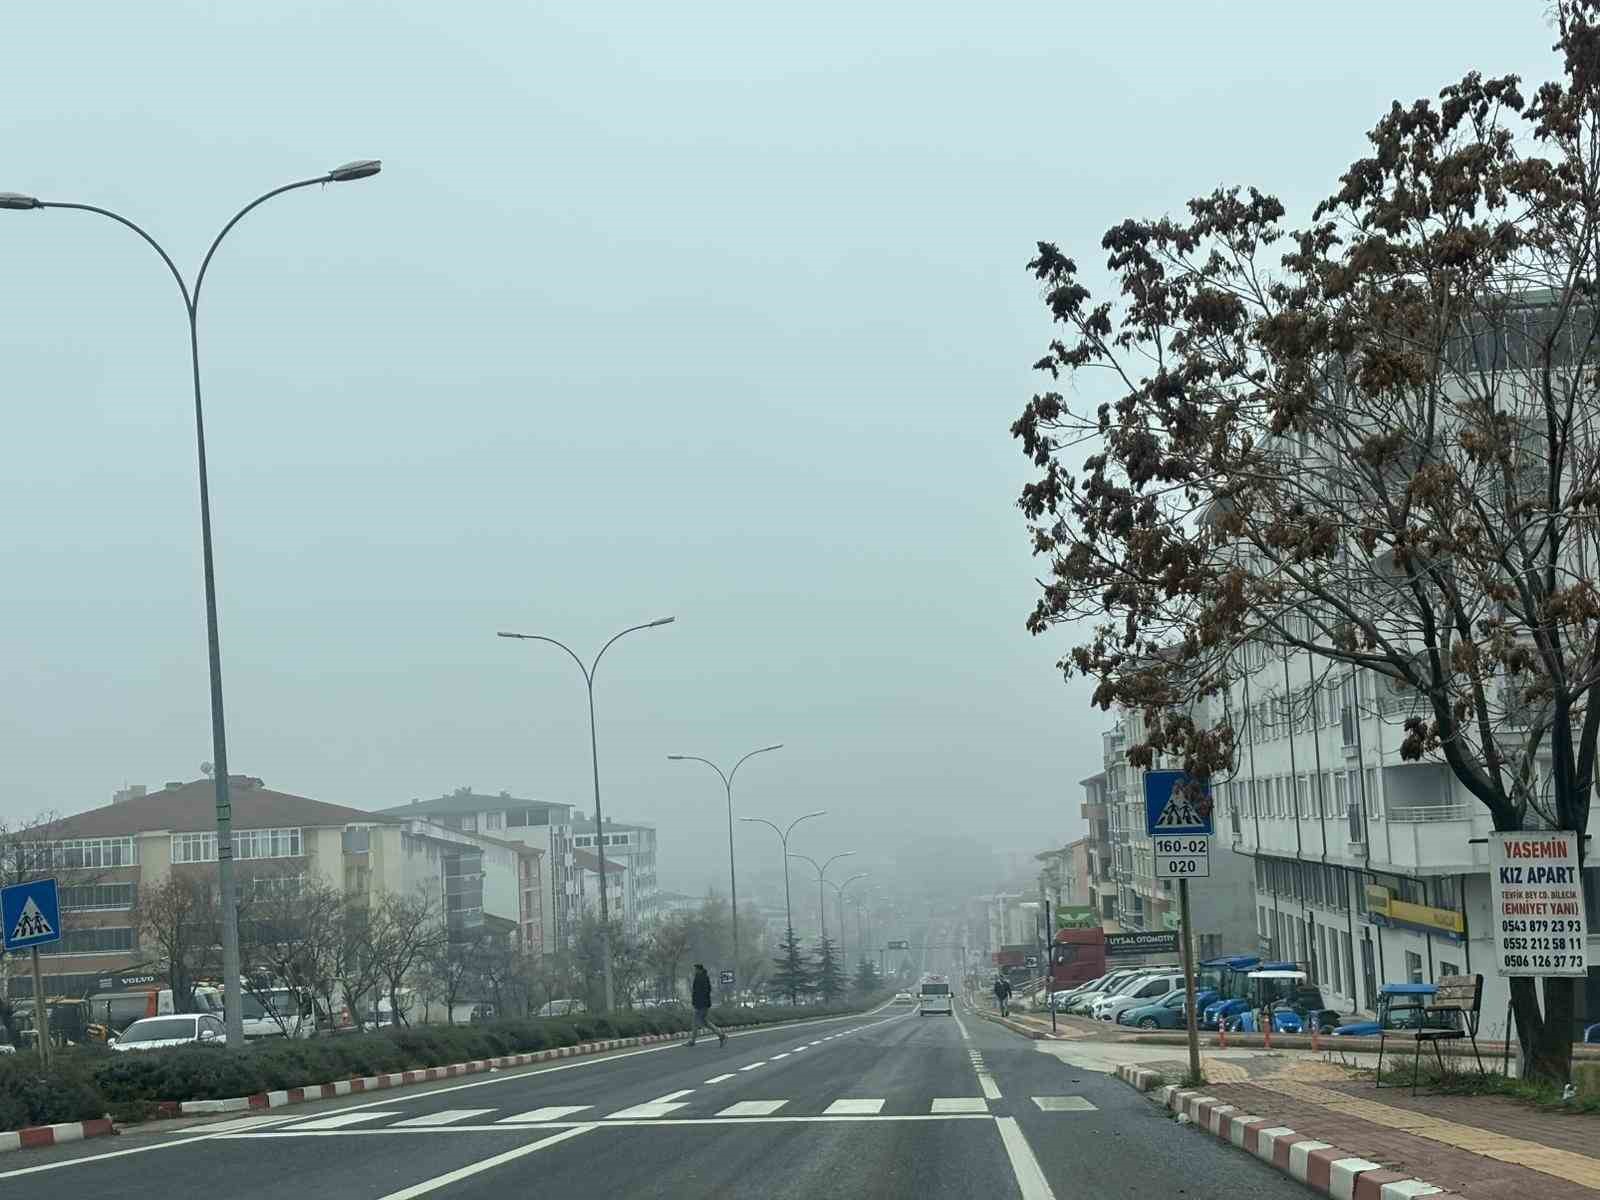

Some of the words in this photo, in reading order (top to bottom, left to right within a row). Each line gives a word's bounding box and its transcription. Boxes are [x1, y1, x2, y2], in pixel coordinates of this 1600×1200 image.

[1157, 840, 1206, 853] 160-02
[1504, 837, 1568, 859] YASEMİN
[1169, 860, 1196, 873] 020
[1500, 866, 1522, 884] KIZ
[1527, 866, 1575, 884] APART
[1502, 920, 1527, 932] 0543
[1529, 920, 1548, 932] 879
[1551, 920, 1565, 932] 23
[1567, 920, 1581, 932] 93
[1503, 938, 1528, 950] 0552
[1530, 938, 1550, 950] 212
[1552, 938, 1566, 950] 58
[1569, 938, 1581, 950] 11
[1504, 955, 1529, 967] 0506
[1532, 955, 1551, 967] 126
[1553, 955, 1567, 967] 37
[1569, 955, 1583, 967] 73
[121, 976, 154, 984] VOLVO
